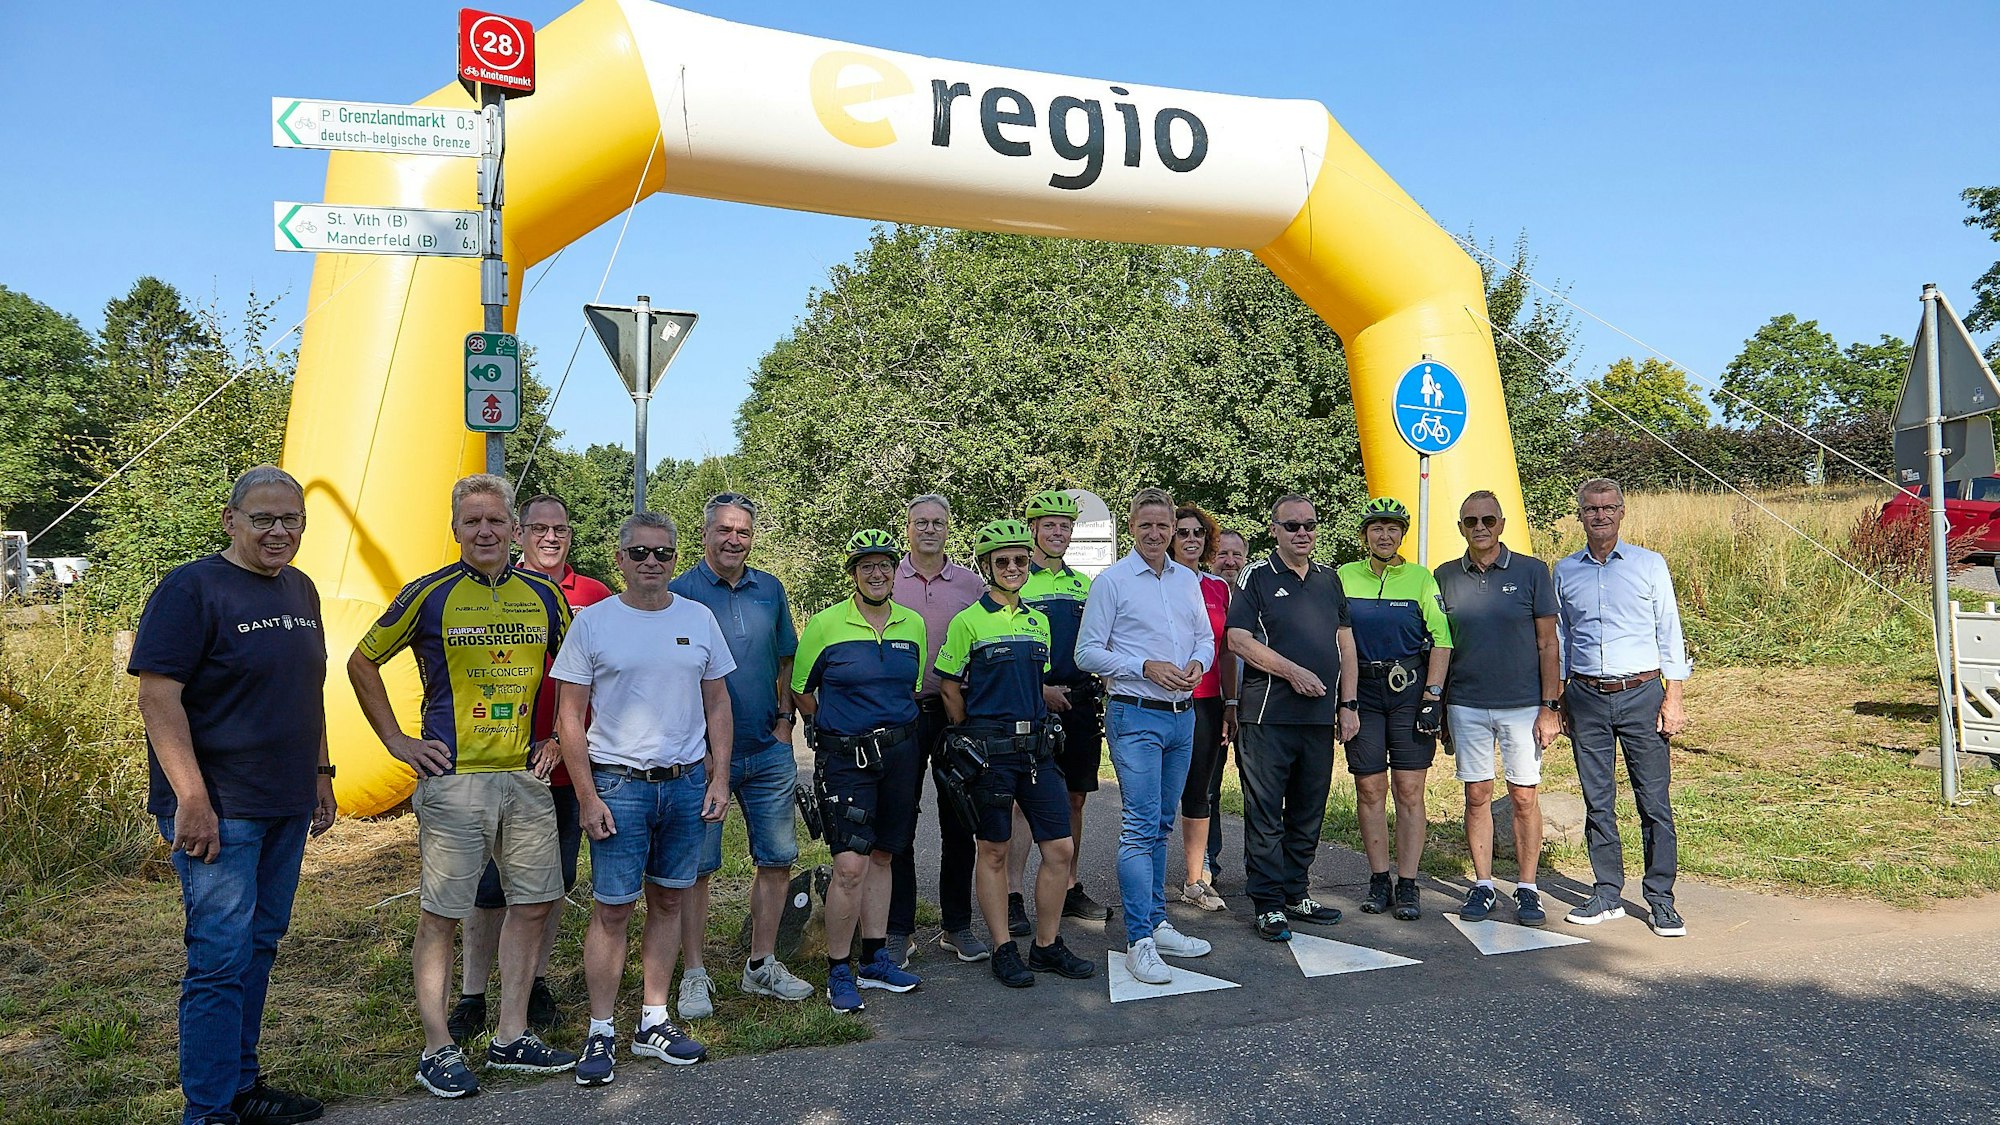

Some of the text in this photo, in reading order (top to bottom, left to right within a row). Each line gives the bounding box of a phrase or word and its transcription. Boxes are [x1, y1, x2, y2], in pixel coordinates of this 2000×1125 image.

[482, 31, 513, 56] 28
[480, 68, 532, 87] Knotenpunkt
[339, 107, 446, 129] Grenzlandmarkt
[456, 116, 475, 131] 0,3
[320, 130, 471, 149] deutsch-belgische Grenze
[930, 78, 1209, 191] regio
[327, 212, 469, 231] St. Vith (B) 26
[327, 231, 476, 250] Manderfeld (B) 6,1
[470, 340, 484, 350] 28
[487, 368, 496, 379] 6
[483, 408, 500, 420] 27
[237, 617, 281, 633] GANT
[448, 627, 486, 635] FAIRPLAY
[487, 623, 526, 634] TOUR
[448, 634, 542, 647] GROSSREGION
[466, 667, 535, 678] VET-CONCEPT
[498, 685, 528, 695] REGION
[473, 723, 510, 738] Fairplay
